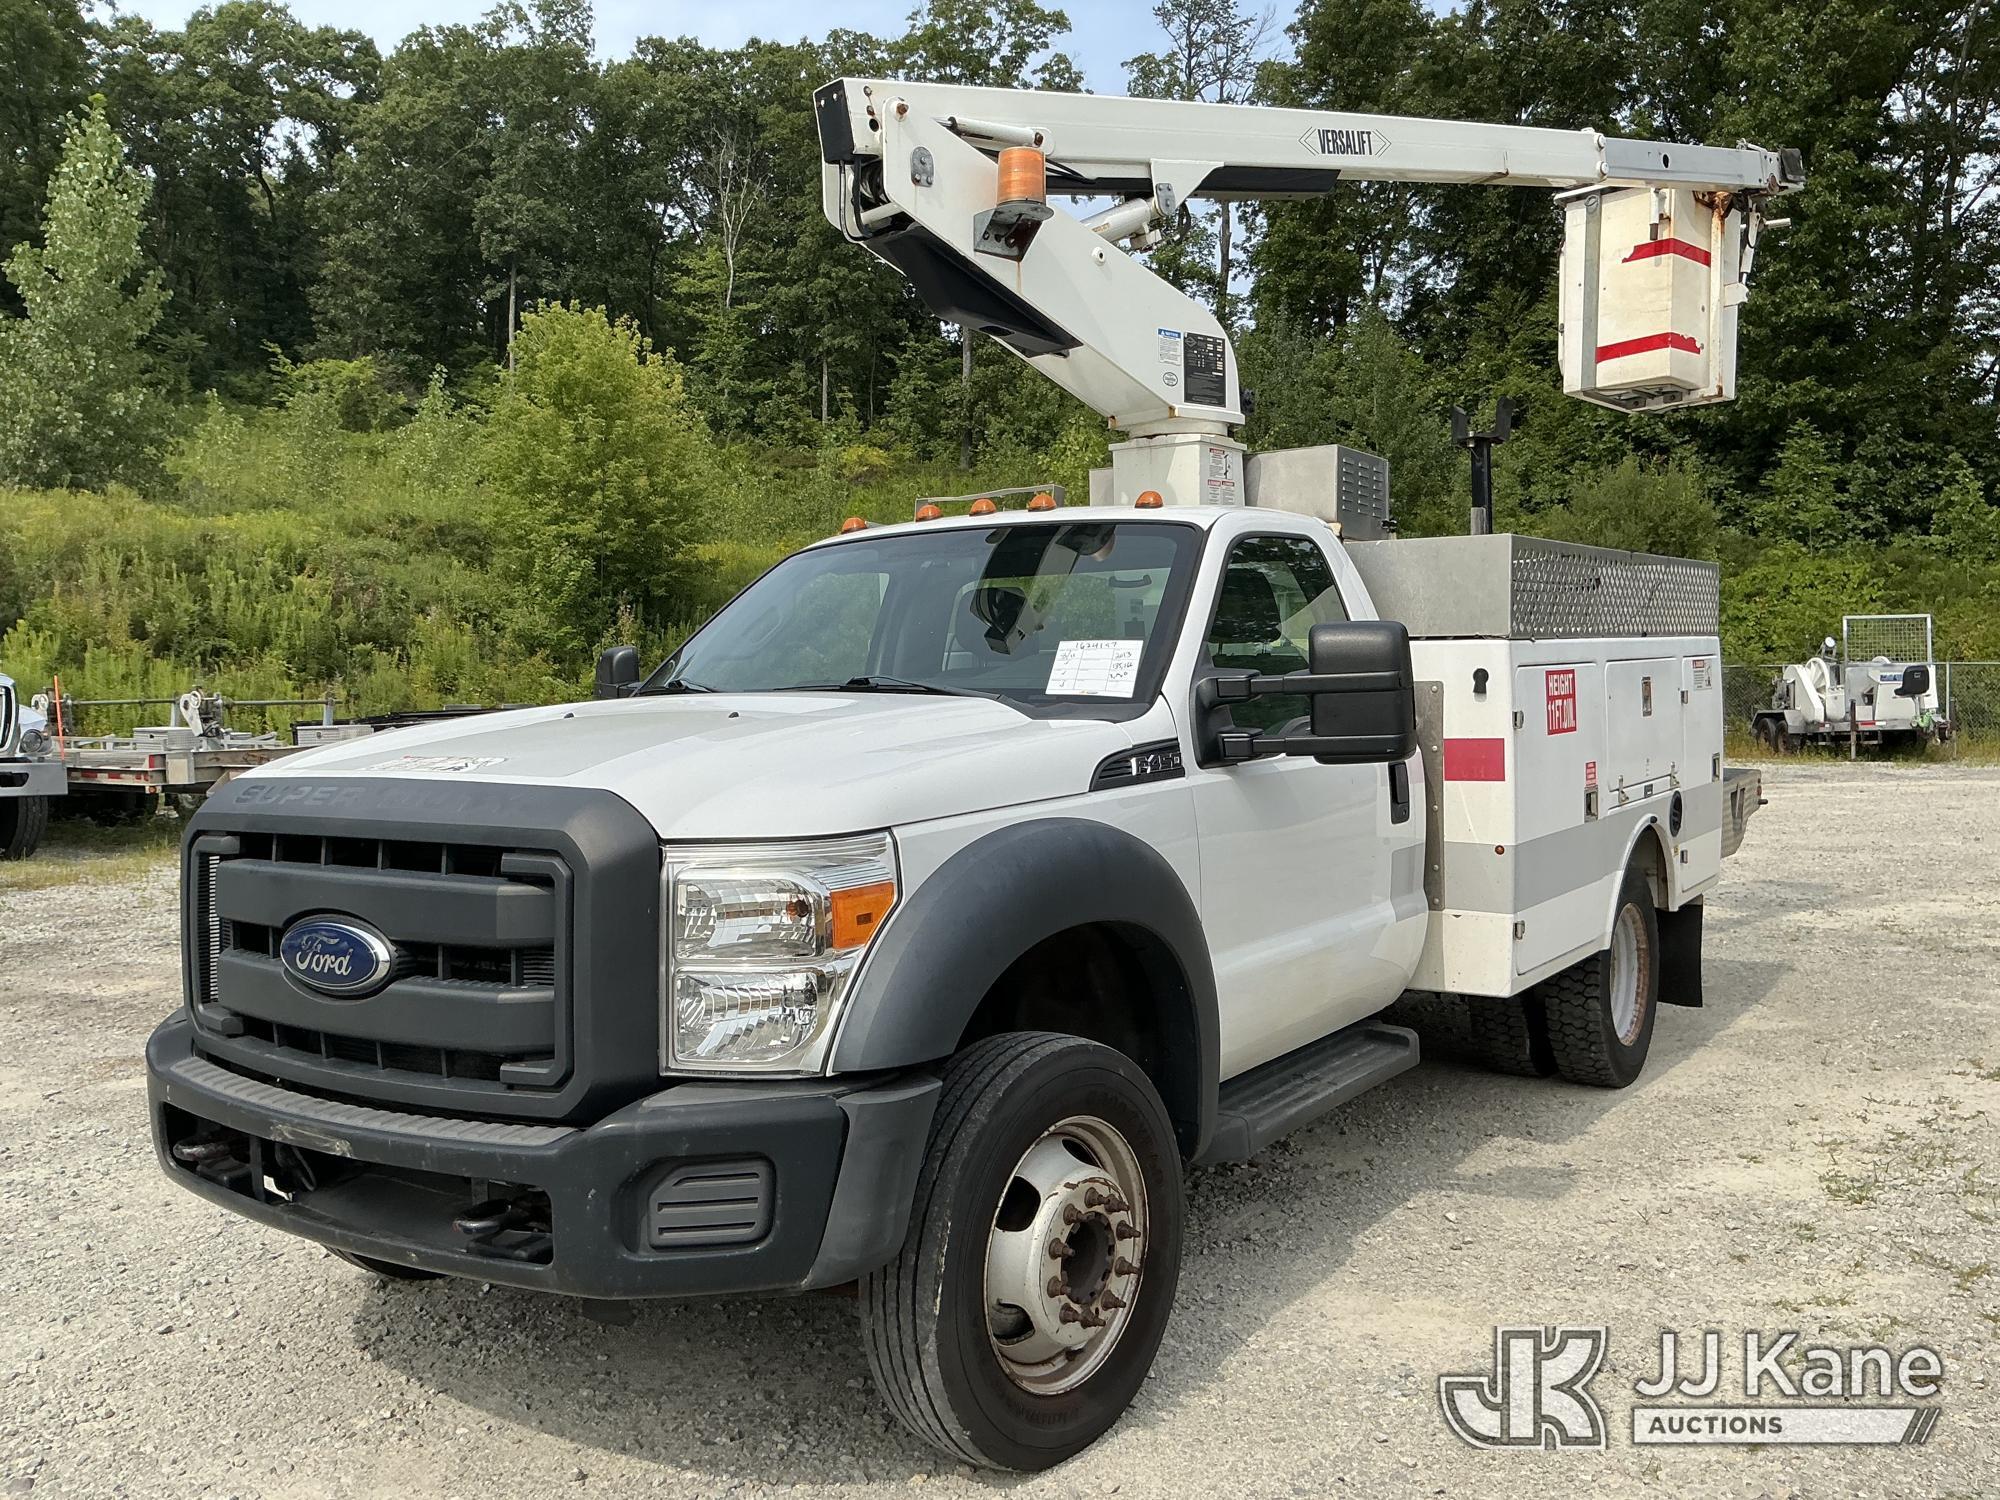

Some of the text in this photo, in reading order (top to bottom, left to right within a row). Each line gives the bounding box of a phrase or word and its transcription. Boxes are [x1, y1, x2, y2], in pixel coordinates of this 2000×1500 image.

[1317, 128, 1373, 156] VERSALIFT
[1548, 674, 1573, 697] HEIGHT
[232, 784, 367, 807] SUPER
[295, 931, 354, 976] Ford
